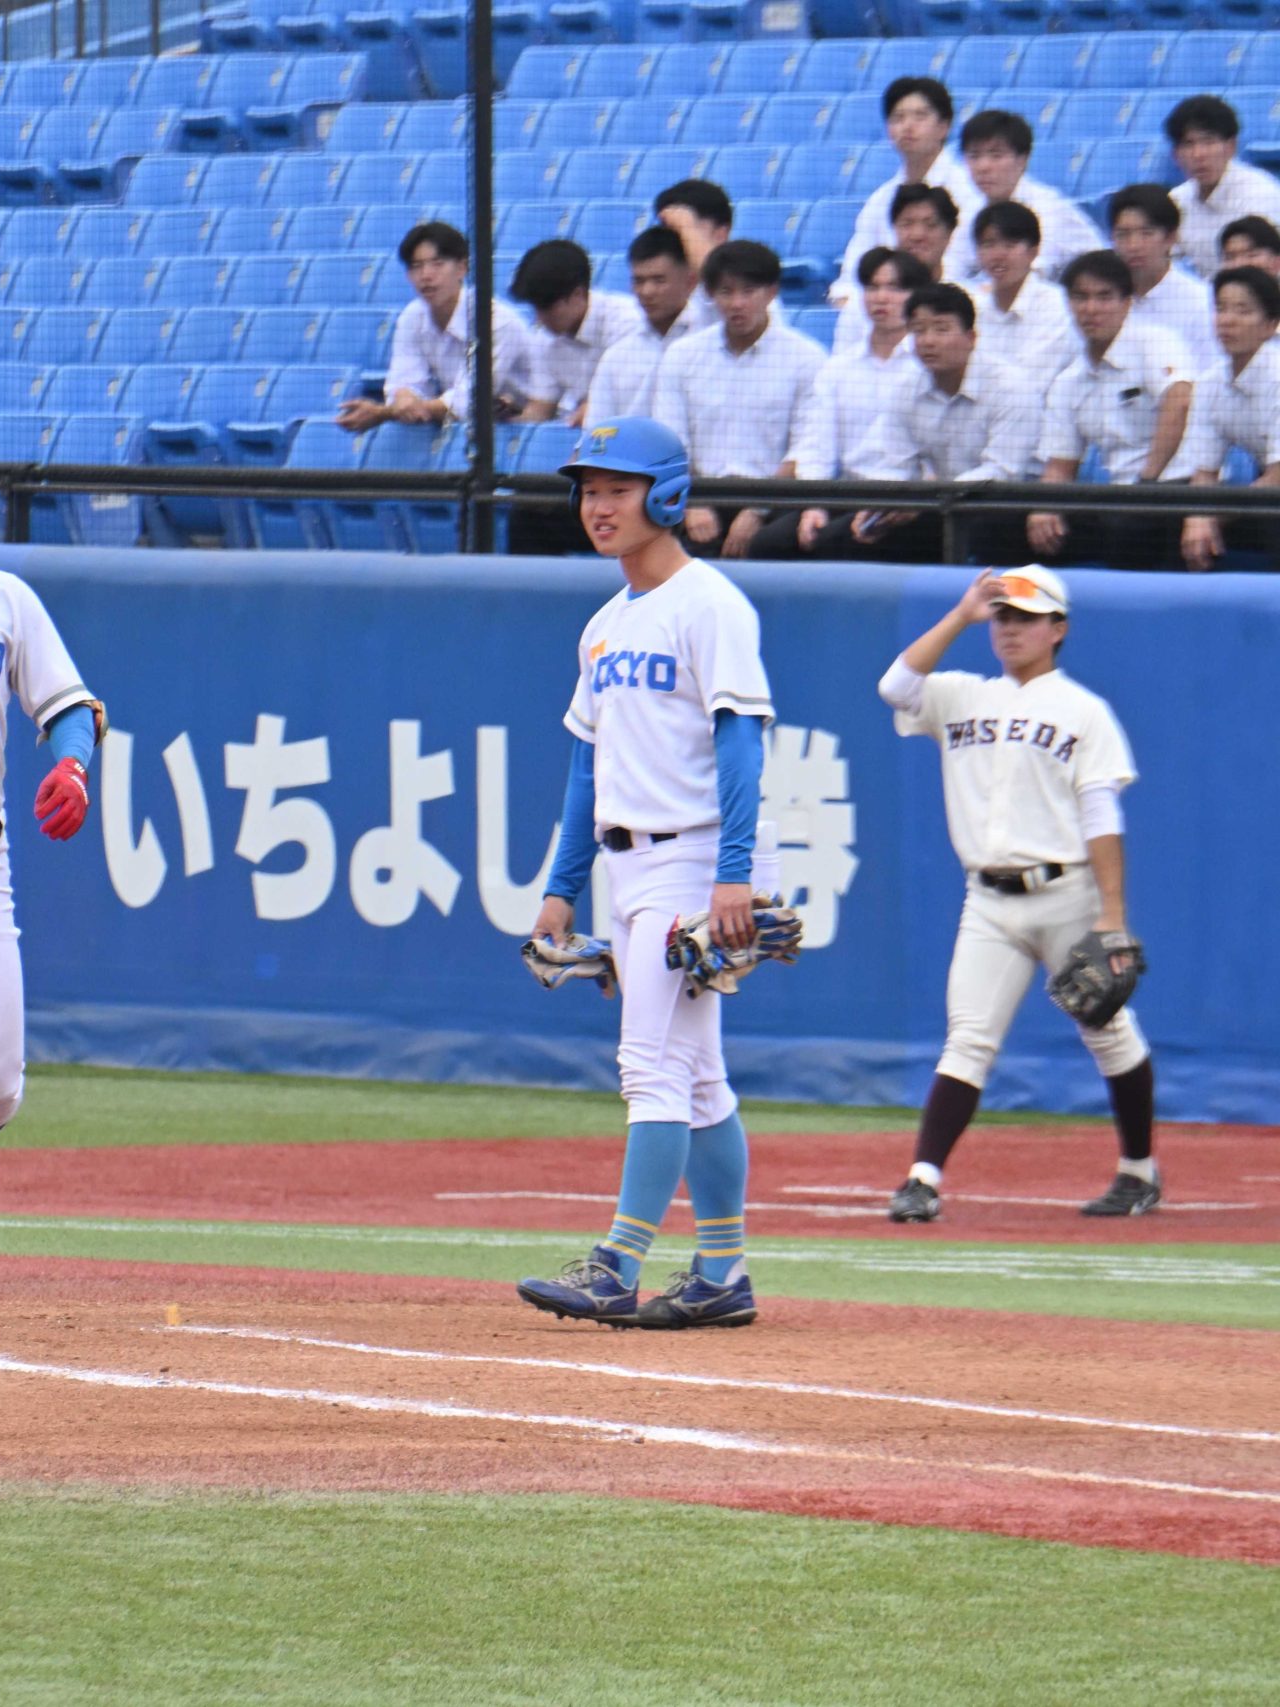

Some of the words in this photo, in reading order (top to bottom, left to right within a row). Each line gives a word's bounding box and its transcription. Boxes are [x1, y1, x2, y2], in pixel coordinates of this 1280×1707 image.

[945, 718, 1079, 763] WASEDA
[100, 712, 860, 949] いちよし券
